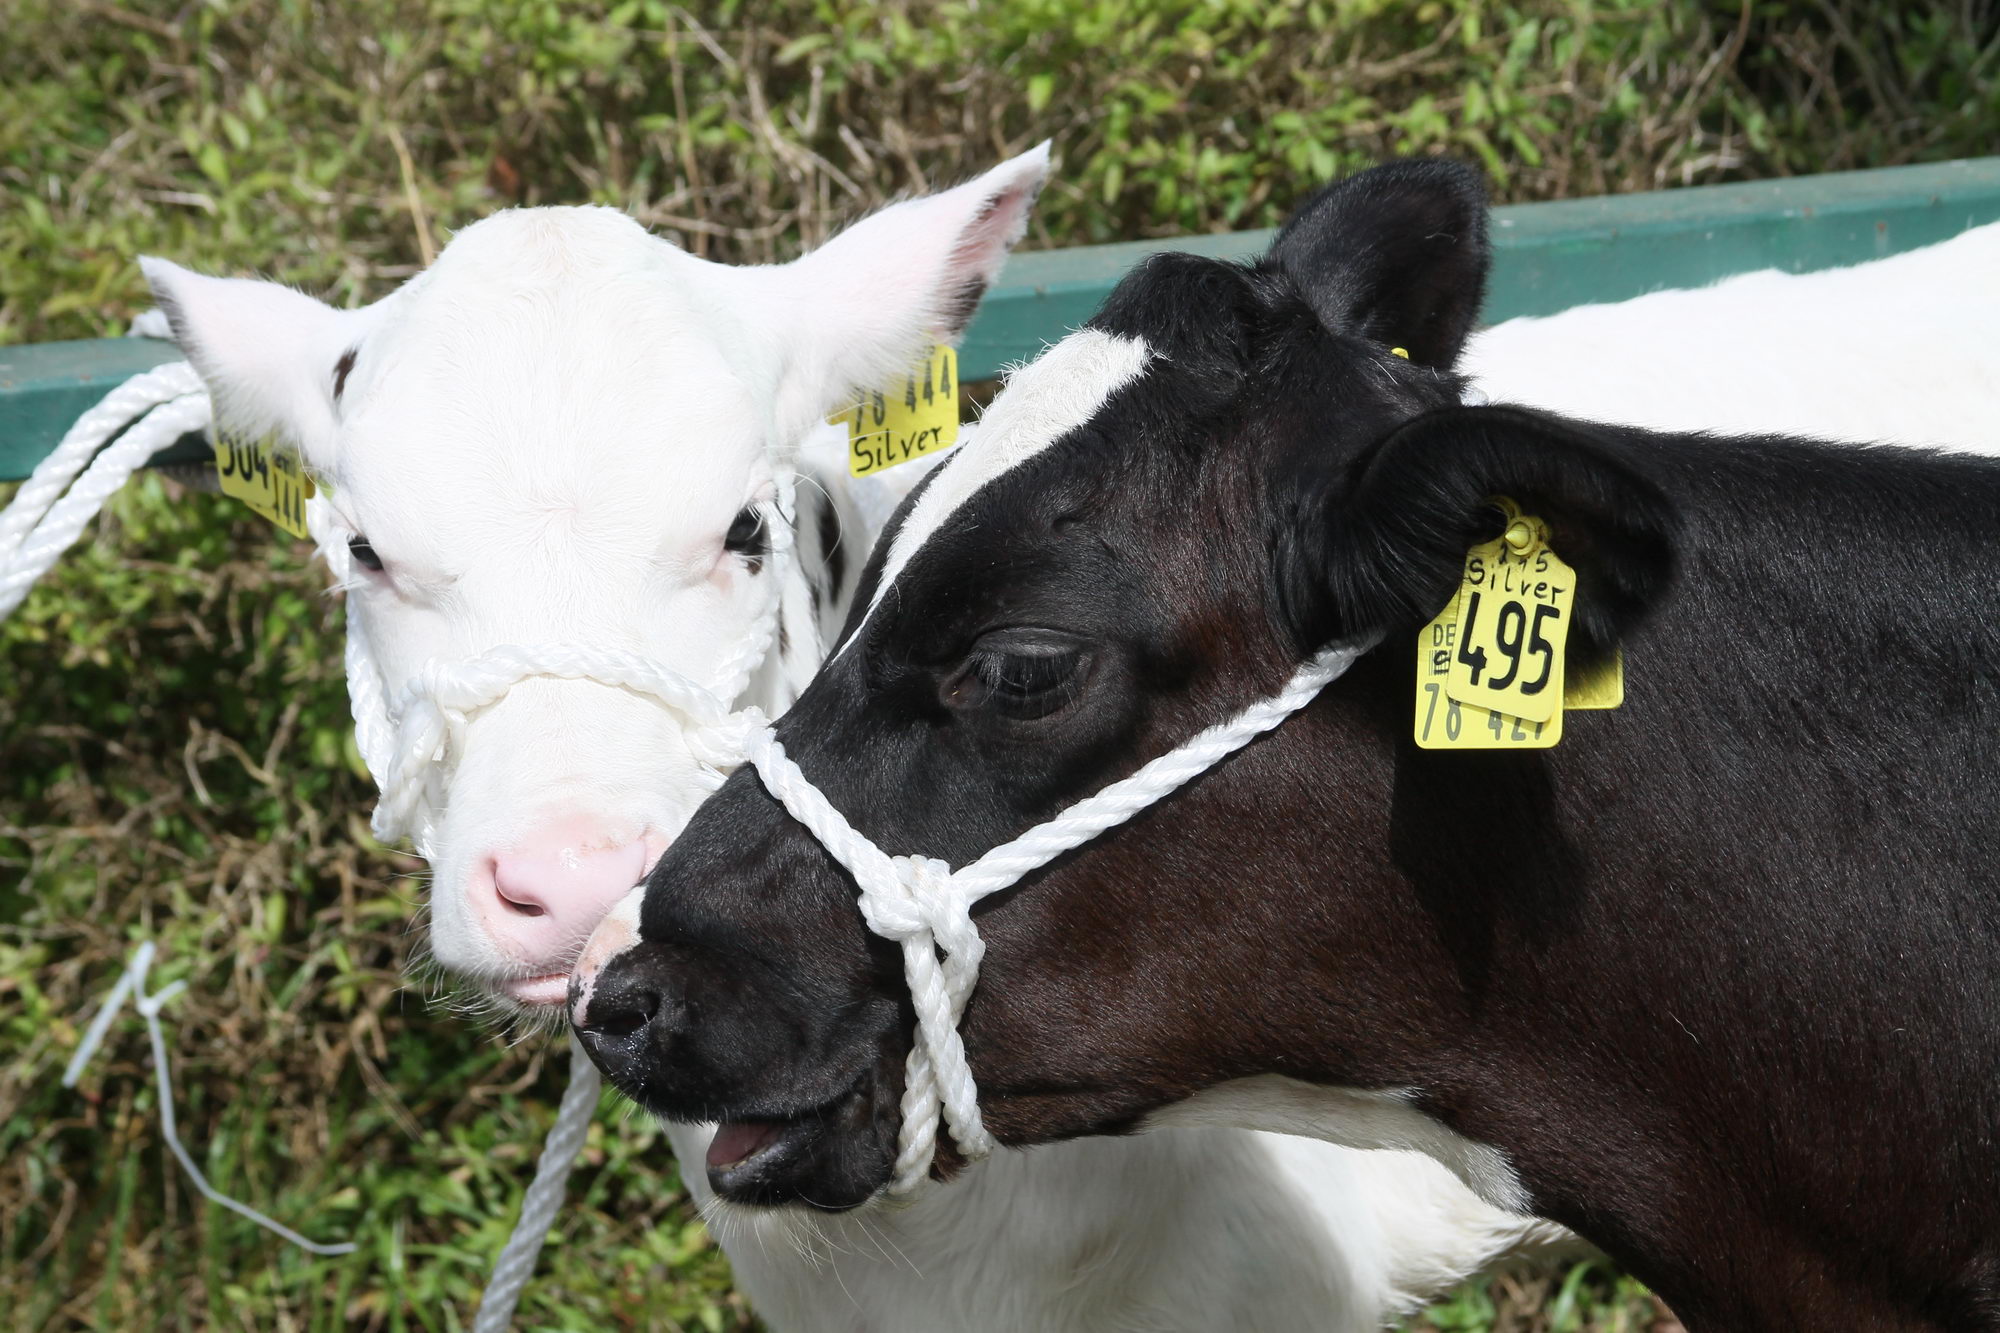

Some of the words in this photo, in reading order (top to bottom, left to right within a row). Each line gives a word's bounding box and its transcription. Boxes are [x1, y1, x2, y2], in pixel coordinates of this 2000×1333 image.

[853, 426, 943, 472] Silver
[1468, 558, 1567, 605] Silver
[1433, 623, 1457, 647] DE
[1457, 590, 1561, 696] 495
